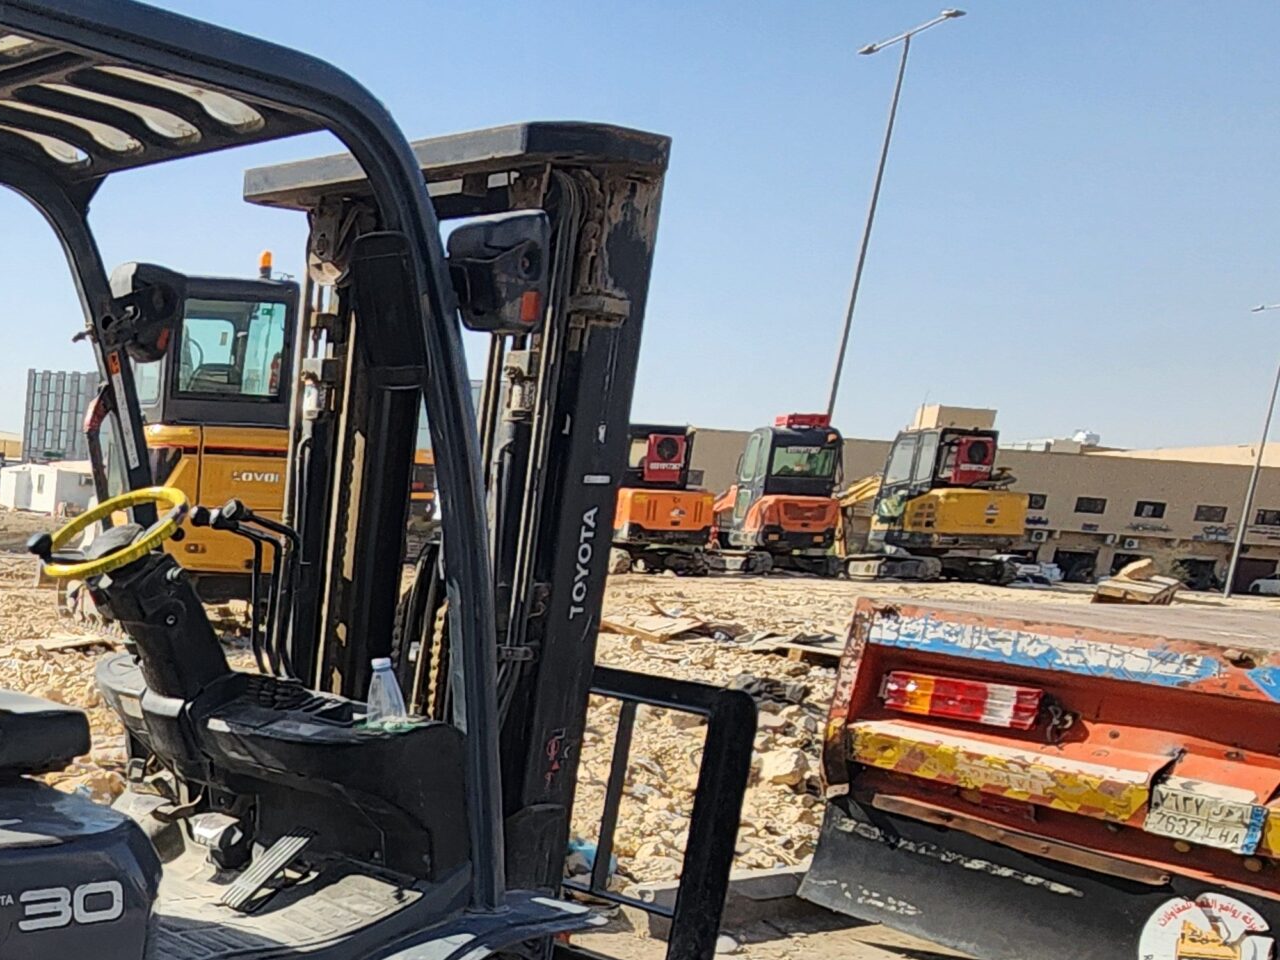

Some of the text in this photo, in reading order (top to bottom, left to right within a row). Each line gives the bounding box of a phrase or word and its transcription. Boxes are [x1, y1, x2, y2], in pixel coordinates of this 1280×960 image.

[569, 507, 598, 619] TOYOTA
[1155, 811, 1201, 838] 7637
[18, 880, 123, 931] 30
